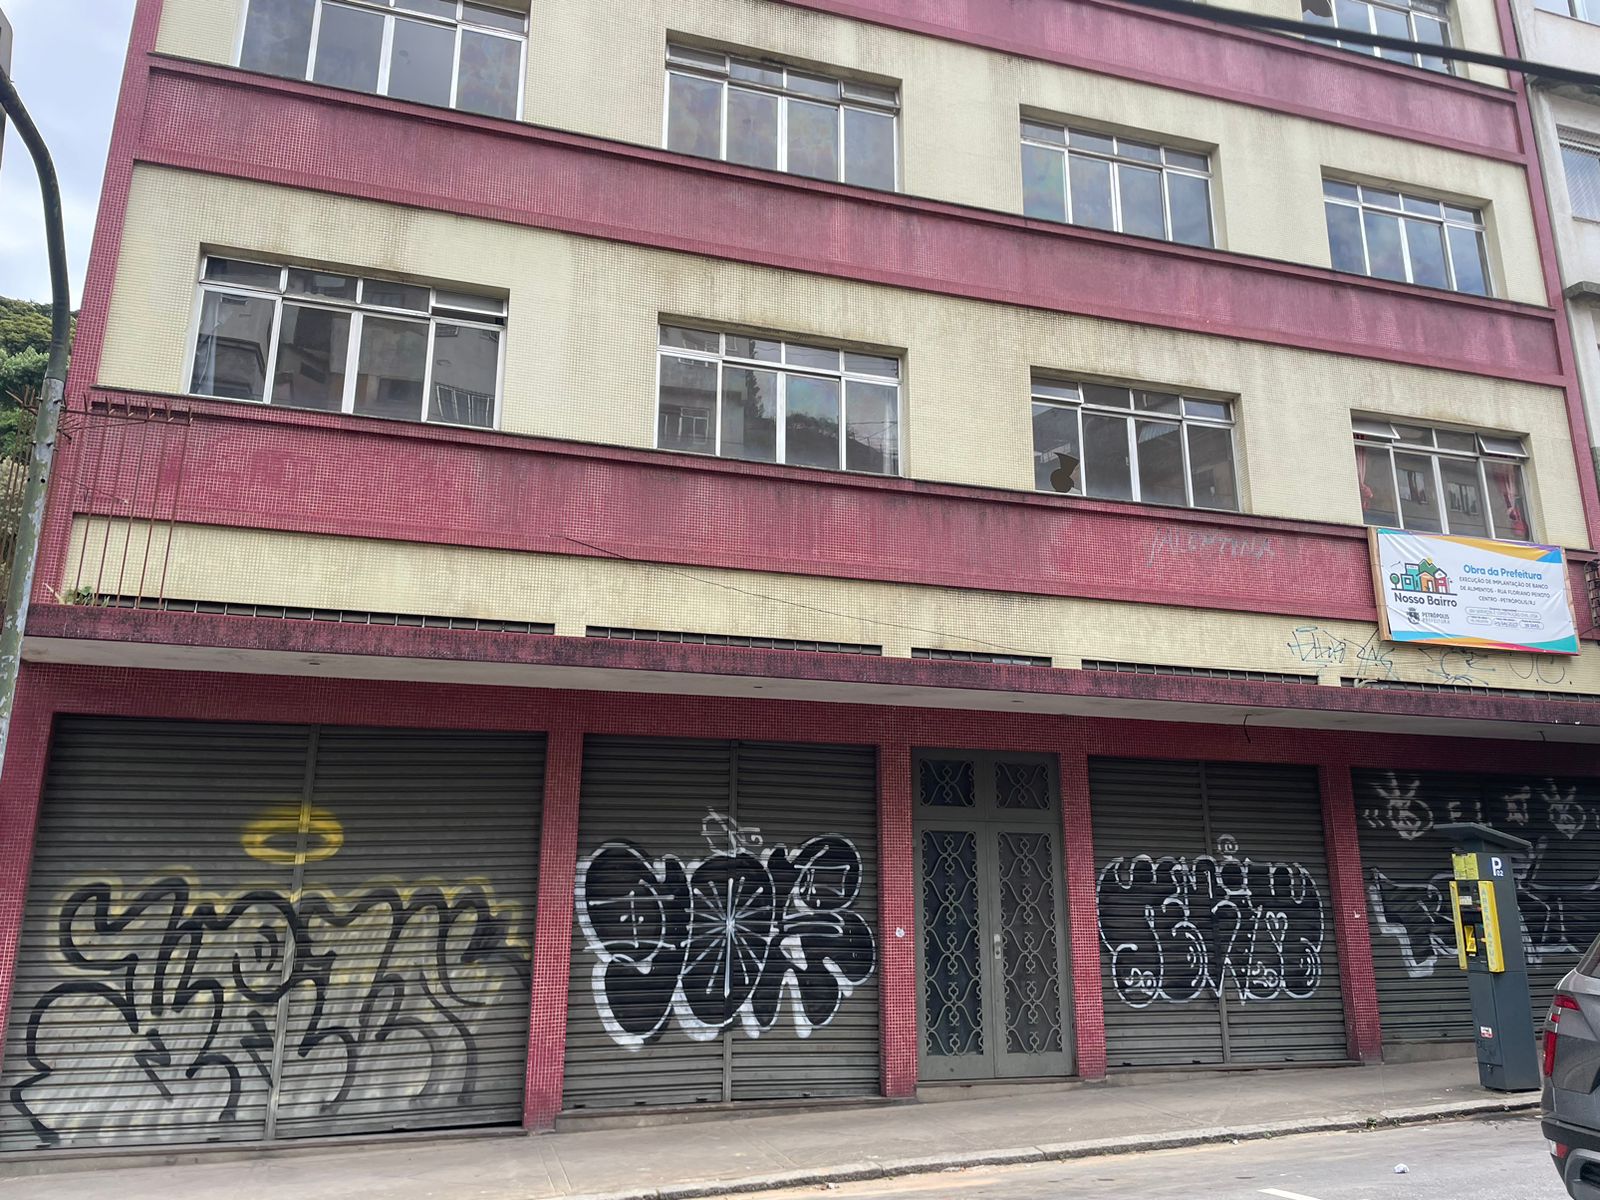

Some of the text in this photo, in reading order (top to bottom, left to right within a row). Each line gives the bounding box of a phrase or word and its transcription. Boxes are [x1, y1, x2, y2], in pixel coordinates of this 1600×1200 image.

[1463, 564, 1542, 580] Obra da Prefeitura
[1459, 576, 1485, 584] EXECUÇÃO
[1492, 579, 1525, 588] IMPLANTAÇÃO
[1393, 592, 1458, 607] Nosso Bairro
